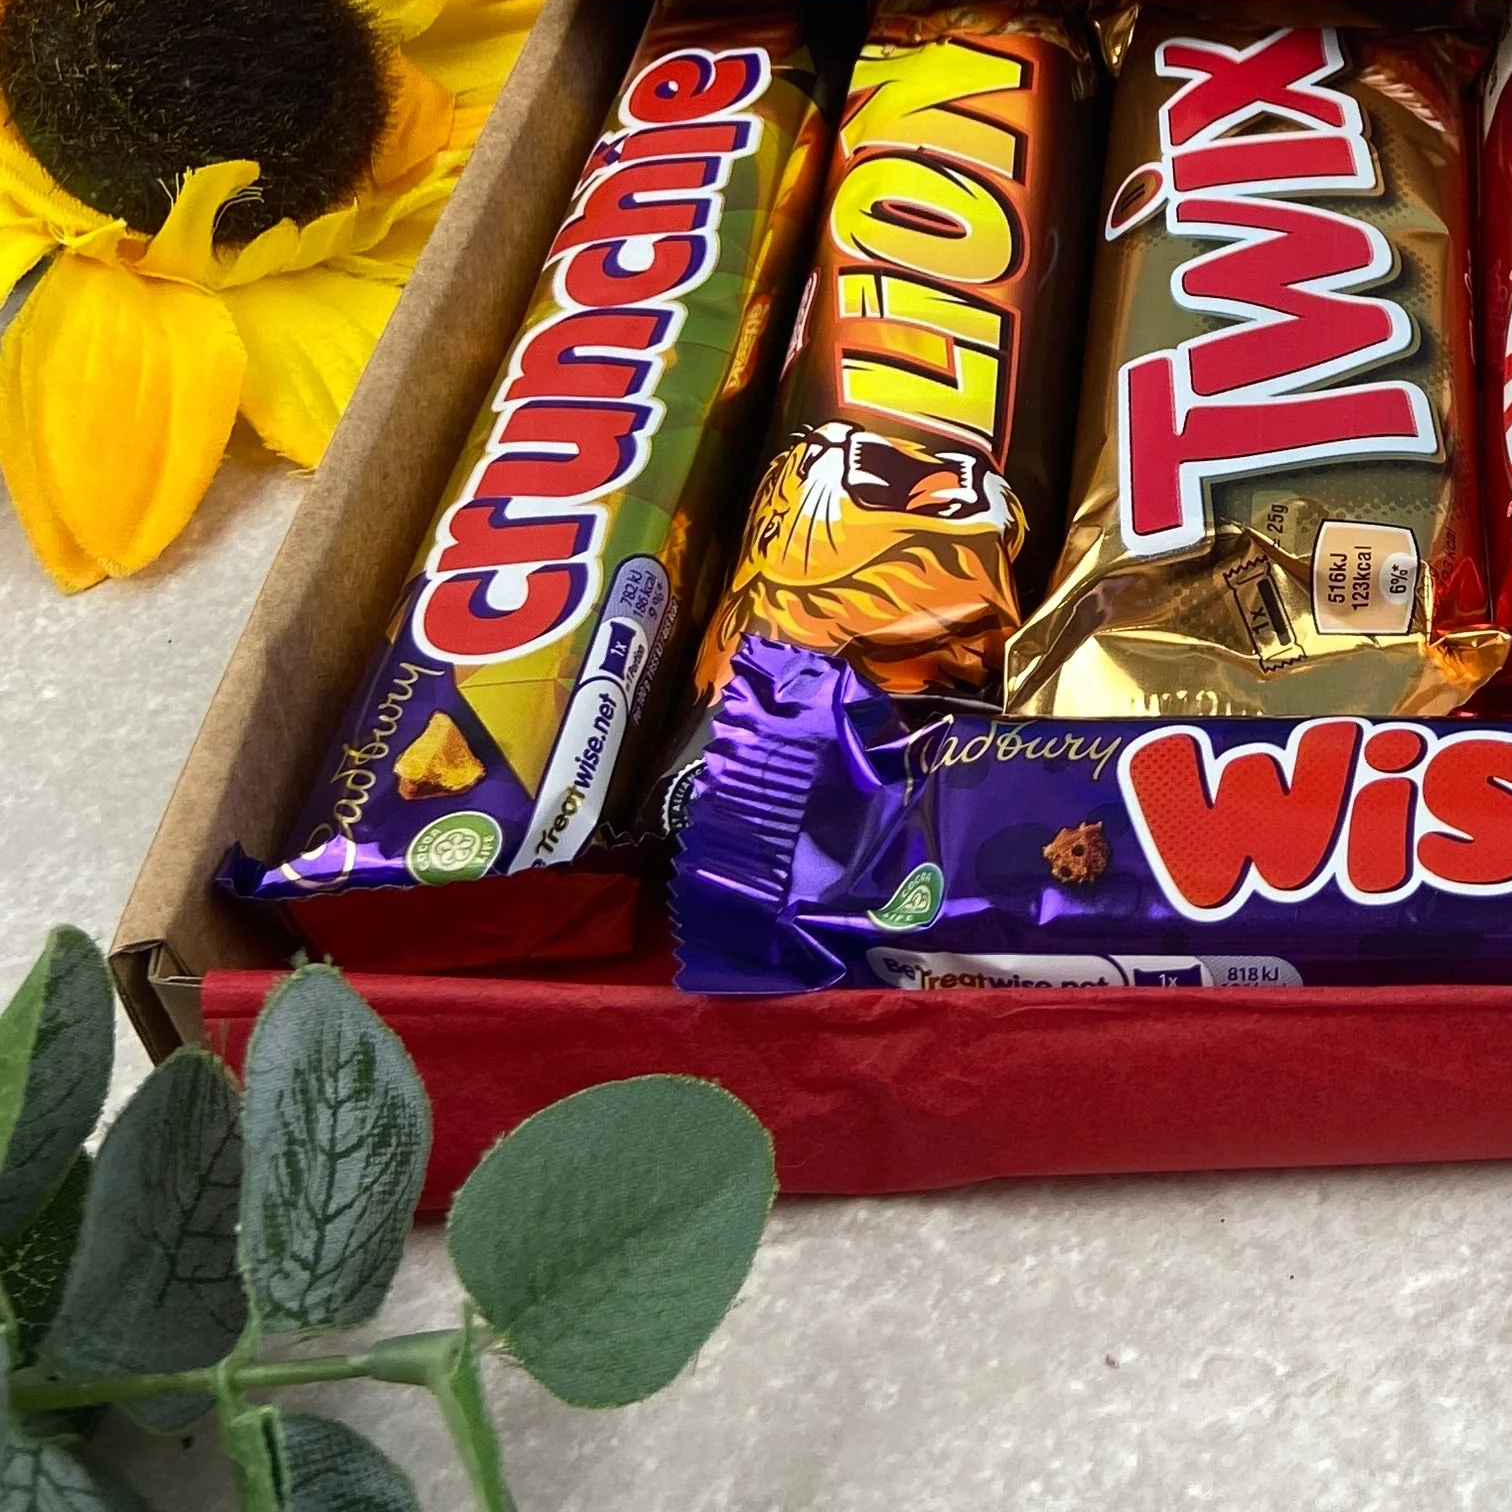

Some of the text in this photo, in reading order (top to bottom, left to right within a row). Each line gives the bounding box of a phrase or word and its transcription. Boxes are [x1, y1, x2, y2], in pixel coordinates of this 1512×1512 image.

[1267, 503, 1290, 534] 25g
[1328, 552, 1349, 604] 516kJ
[1351, 545, 1372, 611] 123kcal
[281, 661, 445, 892] Cadbury
[535, 692, 618, 856] Treatwise.net
[1227, 965, 1280, 983] 818 kJ
